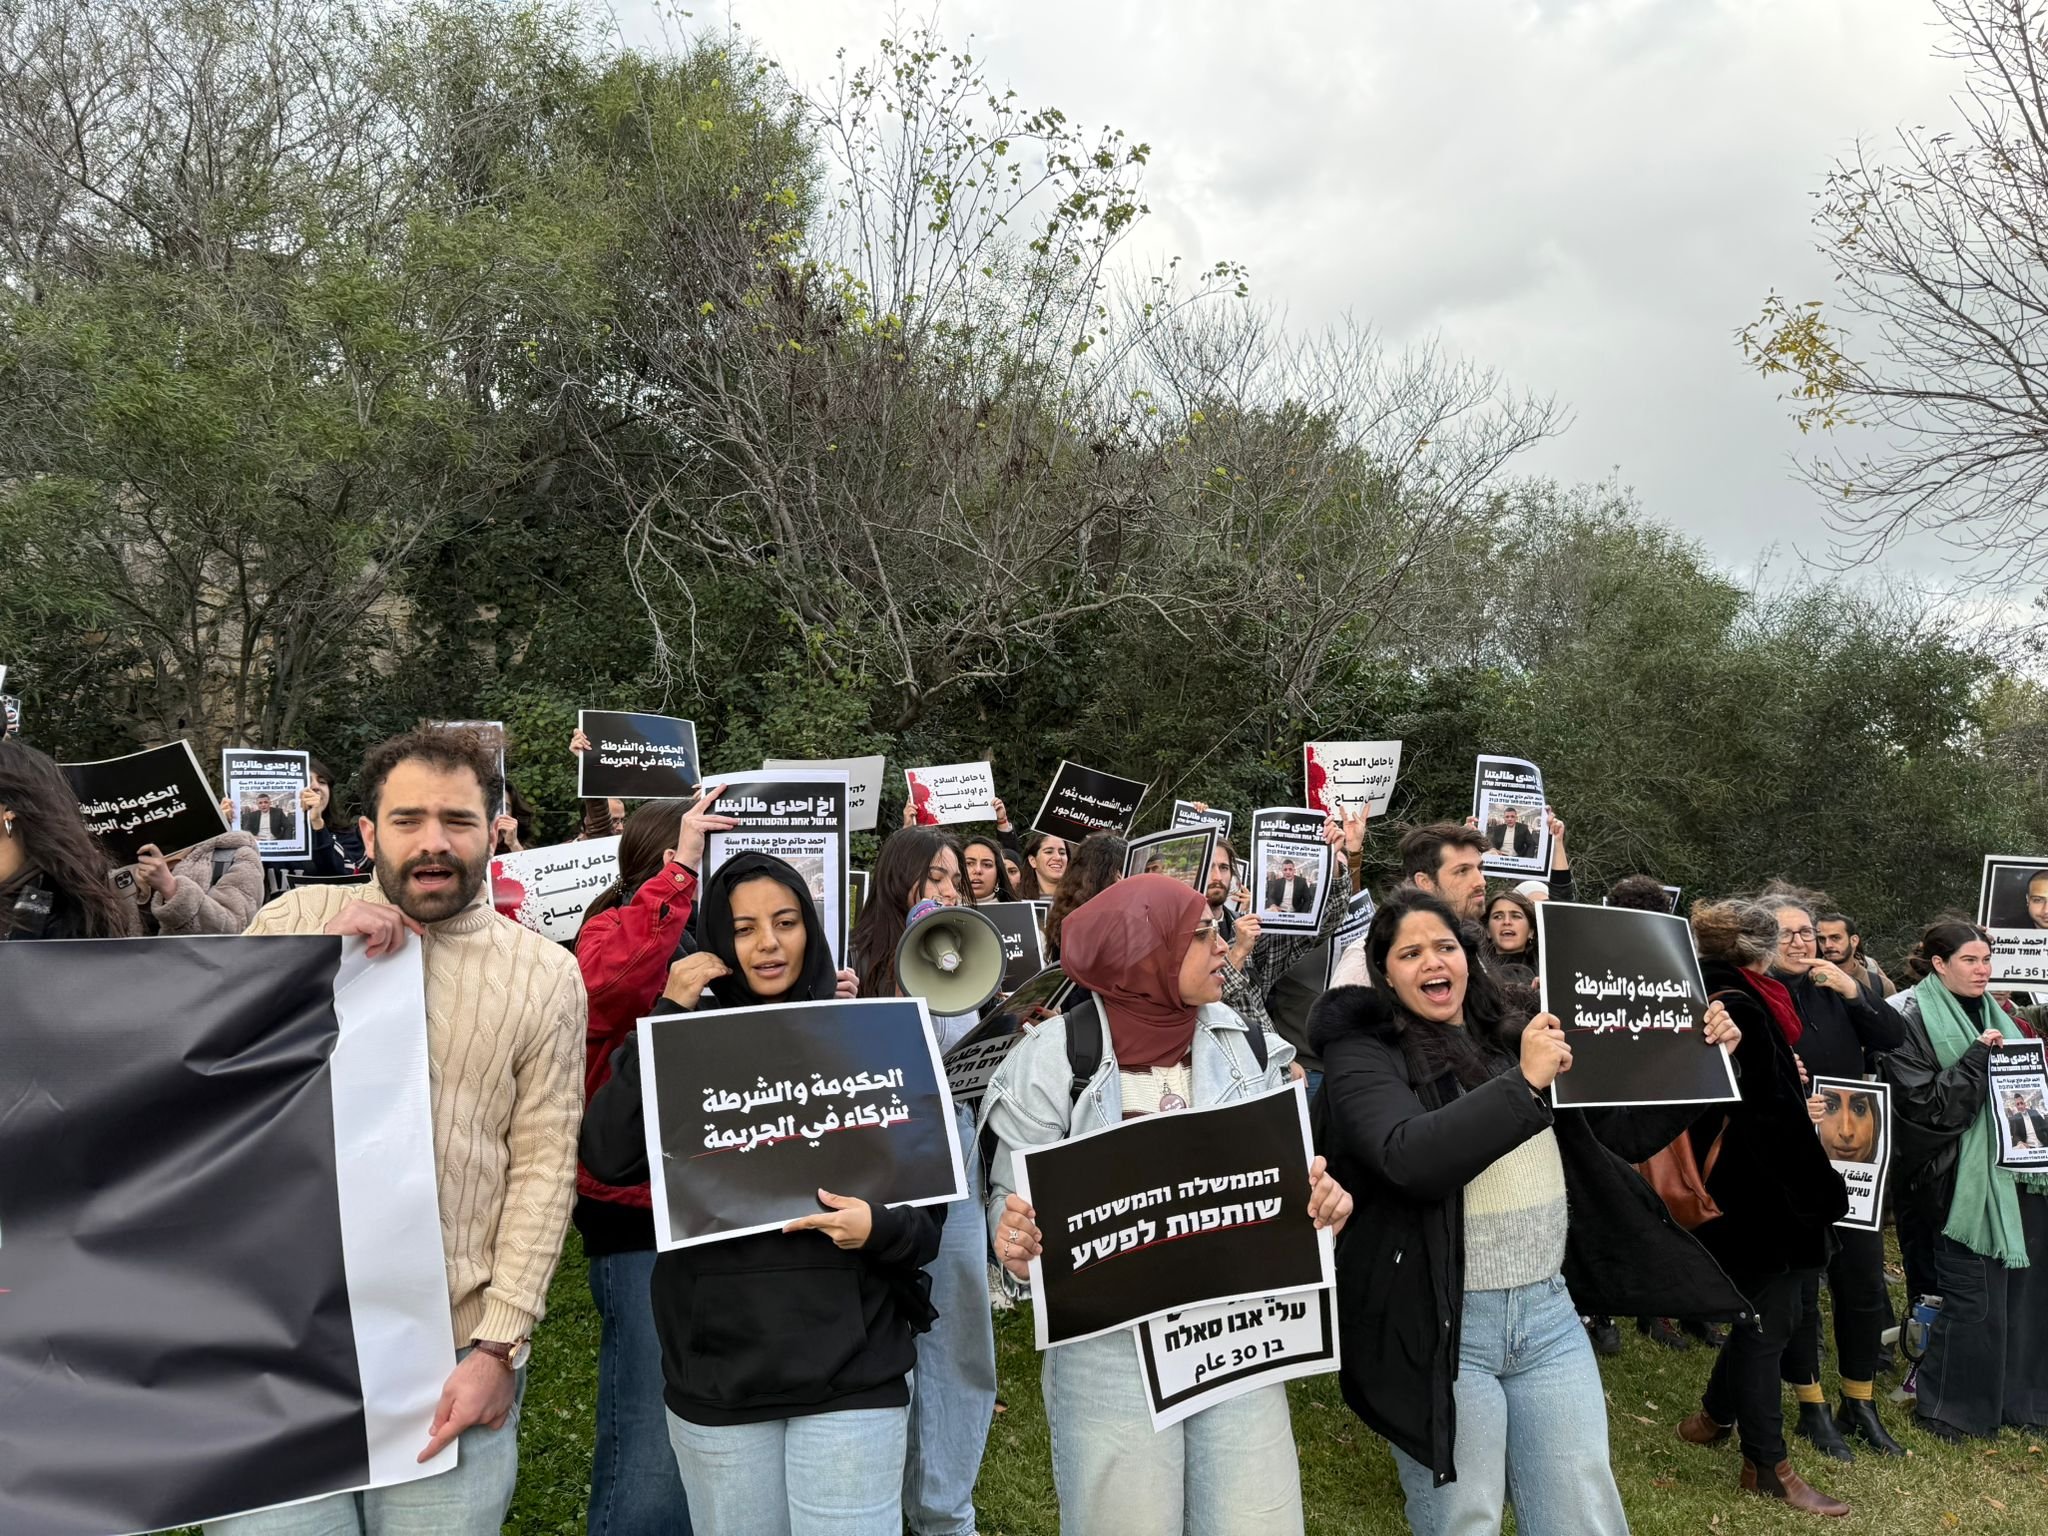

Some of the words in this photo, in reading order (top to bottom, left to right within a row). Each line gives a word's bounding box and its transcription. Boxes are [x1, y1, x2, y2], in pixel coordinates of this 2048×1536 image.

[600, 739, 645, 754] والشرطة
[645, 741, 684, 755] الحكومة
[600, 753, 638, 768] الجريمة
[639, 755, 656, 771] في
[657, 756, 686, 769] شركاء
[1333, 757, 1366, 771] السلاح
[1367, 757, 1388, 769] حامل
[933, 776, 958, 787] السلاح
[960, 774, 978, 784] حامل
[117, 784, 180, 809] الحكومة
[978, 787, 988, 796] دم
[1059, 786, 1079, 801] يثور
[1078, 793, 1097, 806] يهب
[144, 798, 187, 823] شركاء
[770, 797, 813, 816] احدى
[816, 796, 835, 817] اخ
[1096, 797, 1121, 810] الشعب
[85, 818, 119, 835] الجريم
[120, 812, 142, 834] في
[791, 817, 809, 826] אחת
[811, 816, 824, 826] של
[825, 817, 838, 826] אח
[724, 837, 740, 845] سنة
[771, 837, 787, 847] حاج
[788, 837, 807, 846] حاتم
[807, 836, 826, 845] احمد
[534, 859, 579, 881] السلاح
[581, 854, 617, 870] حامل
[2022, 937, 2047, 946] احمد
[2018, 948, 2041, 956] אחמד
[2003, 965, 2022, 978] عام
[2024, 967, 2039, 977] 36
[1574, 969, 1636, 1002] والشرطة
[1637, 974, 1692, 1002] الحكومة
[1574, 1003, 1627, 1035] الجريمة
[1628, 1004, 1652, 1040] في
[1653, 1003, 1693, 1034] شركاء
[811, 1067, 904, 1098] الحكومة
[702, 1076, 808, 1113] والشرطة
[844, 1093, 909, 1128] شركاء
[703, 1115, 795, 1152] الجريمة
[799, 1104, 840, 1147] في
[1178, 1167, 1280, 1200] הממשלה
[1067, 1186, 1172, 1233] והמשטרה
[1167, 1197, 1283, 1238] שותפות
[1071, 1218, 1157, 1270] לפשע
[1227, 1308, 1263, 1333] אבו
[1165, 1318, 1223, 1353] סאלח
[1231, 1344, 1258, 1367] 30
[1262, 1338, 1285, 1359] בן
[1195, 1352, 1226, 1383] عام
